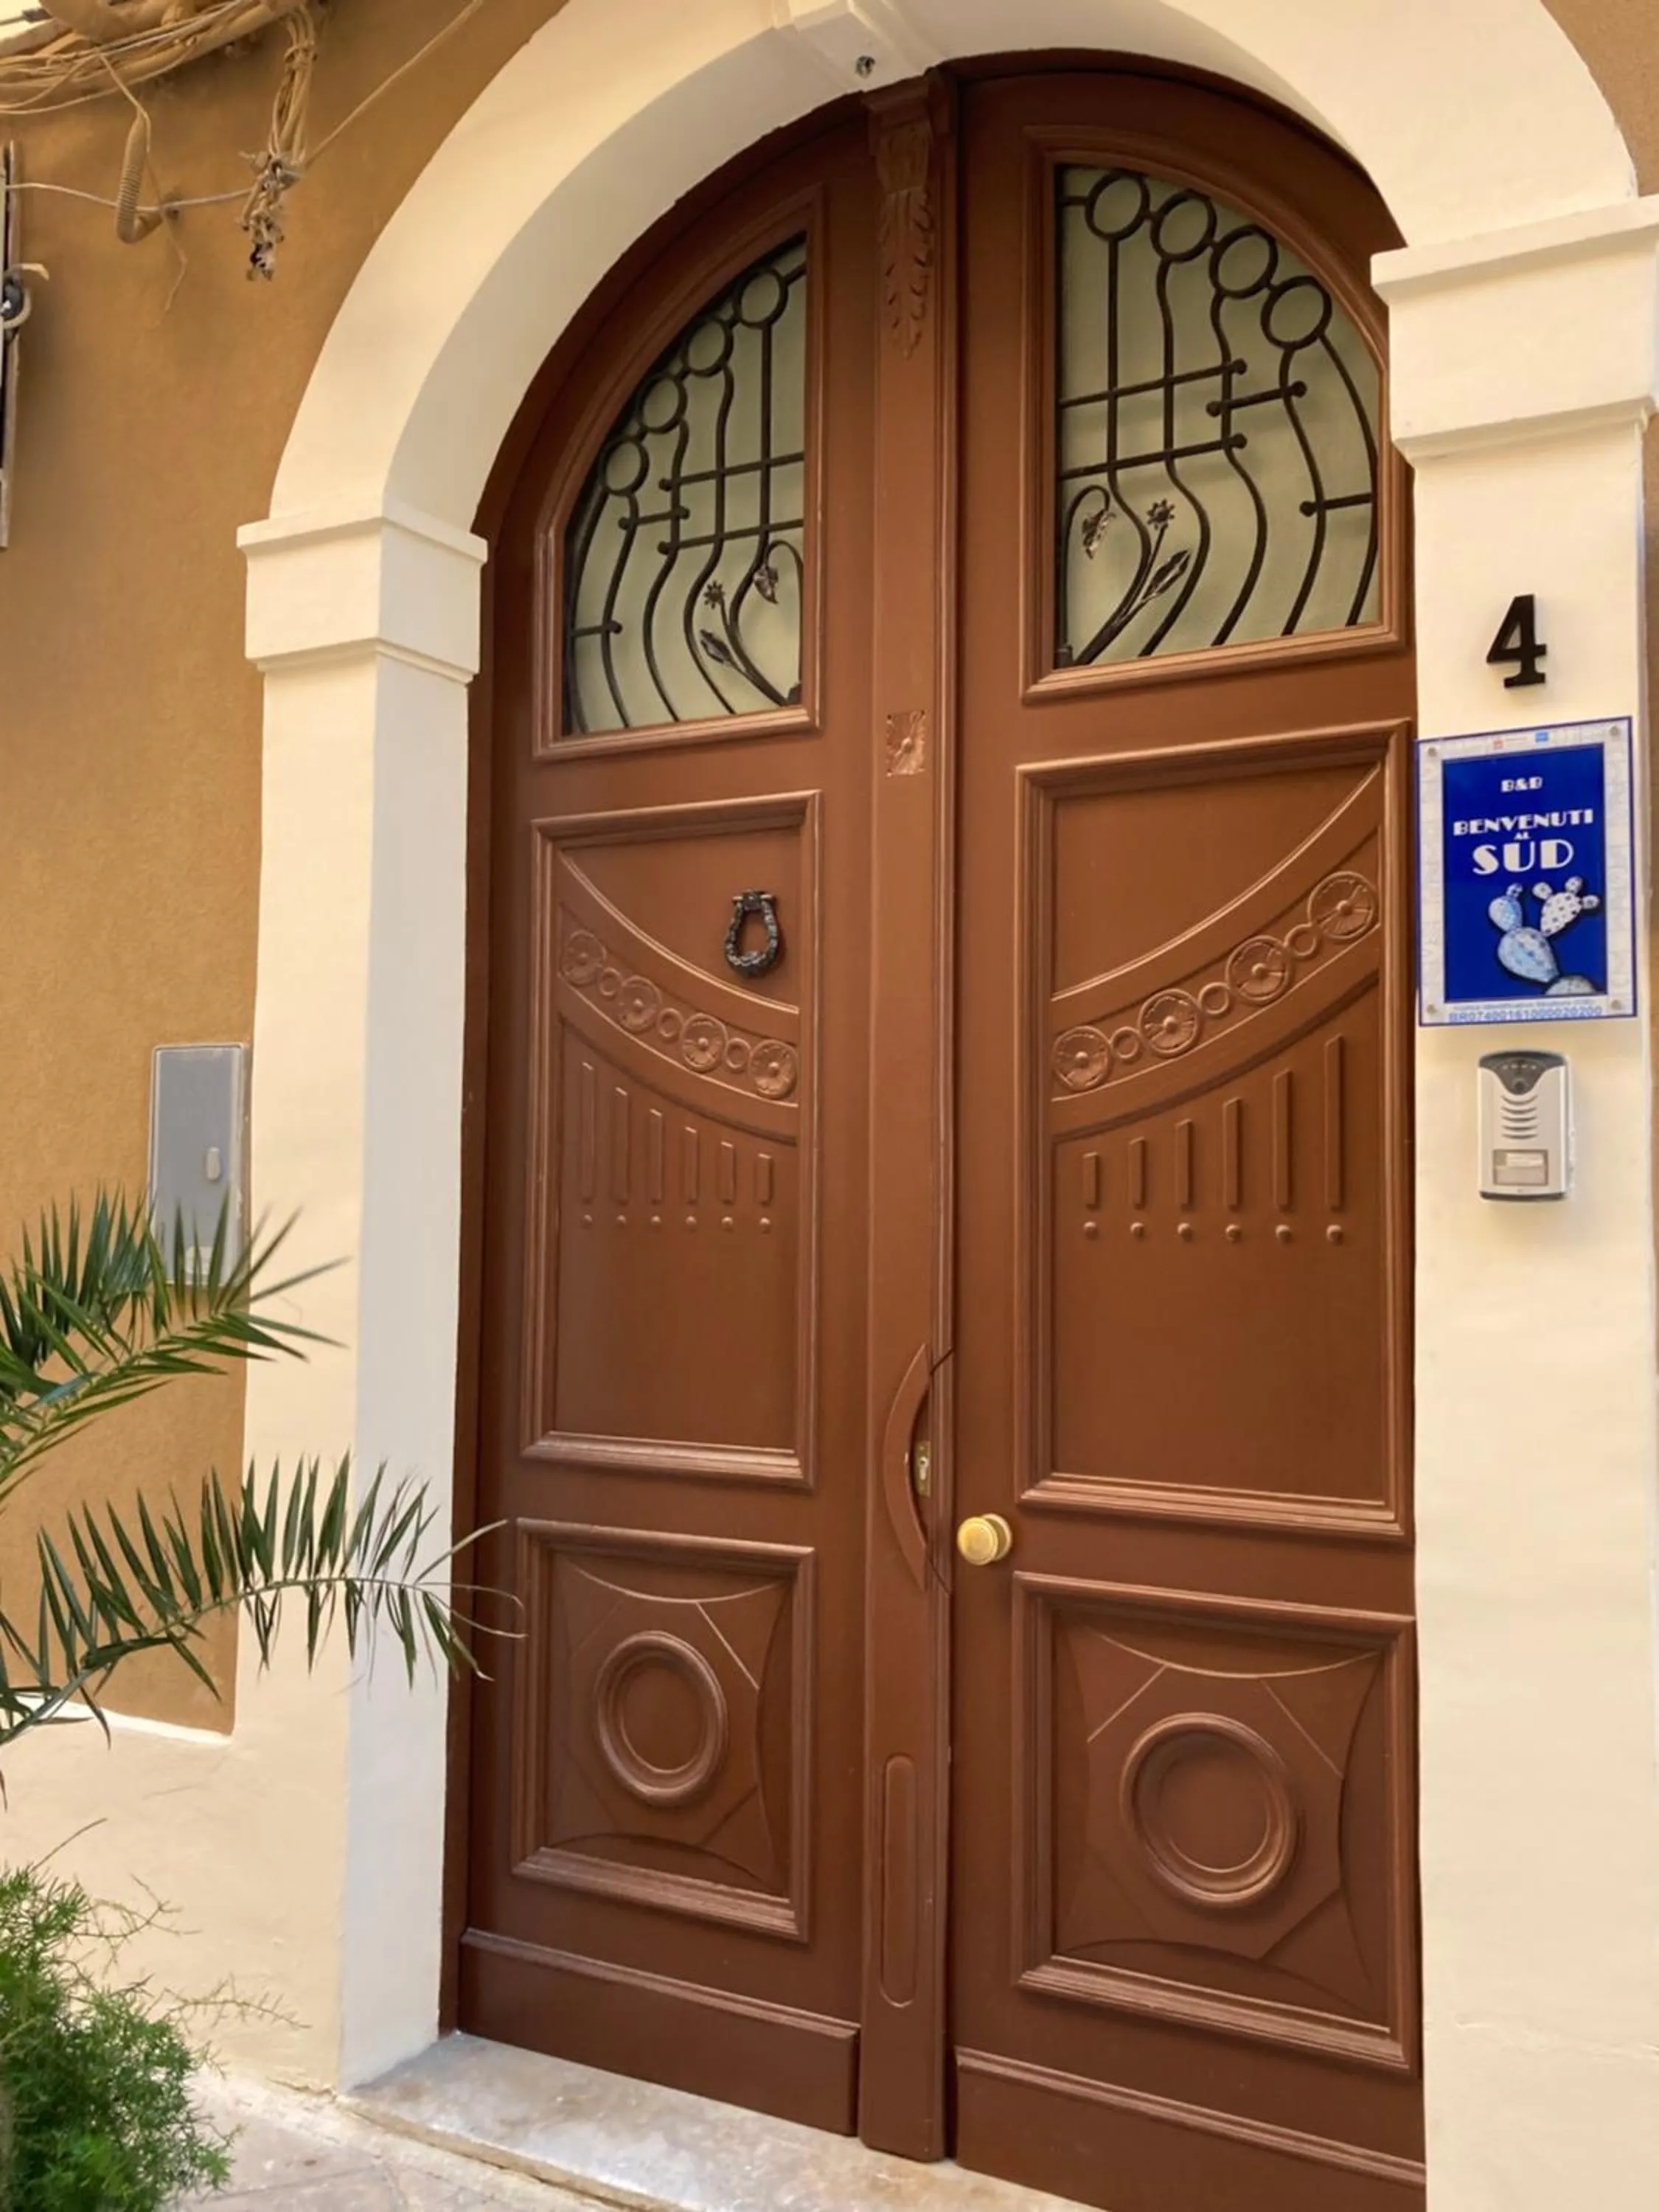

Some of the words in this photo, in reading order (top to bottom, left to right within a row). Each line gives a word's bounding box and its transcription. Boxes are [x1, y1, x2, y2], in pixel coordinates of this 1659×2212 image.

[1486, 594, 1547, 688] 4
[1501, 776, 1543, 793] B&B
[1453, 809, 1593, 836] BENVENUTI
[1514, 831, 1530, 841] AL
[1472, 839, 1575, 875] SUD
